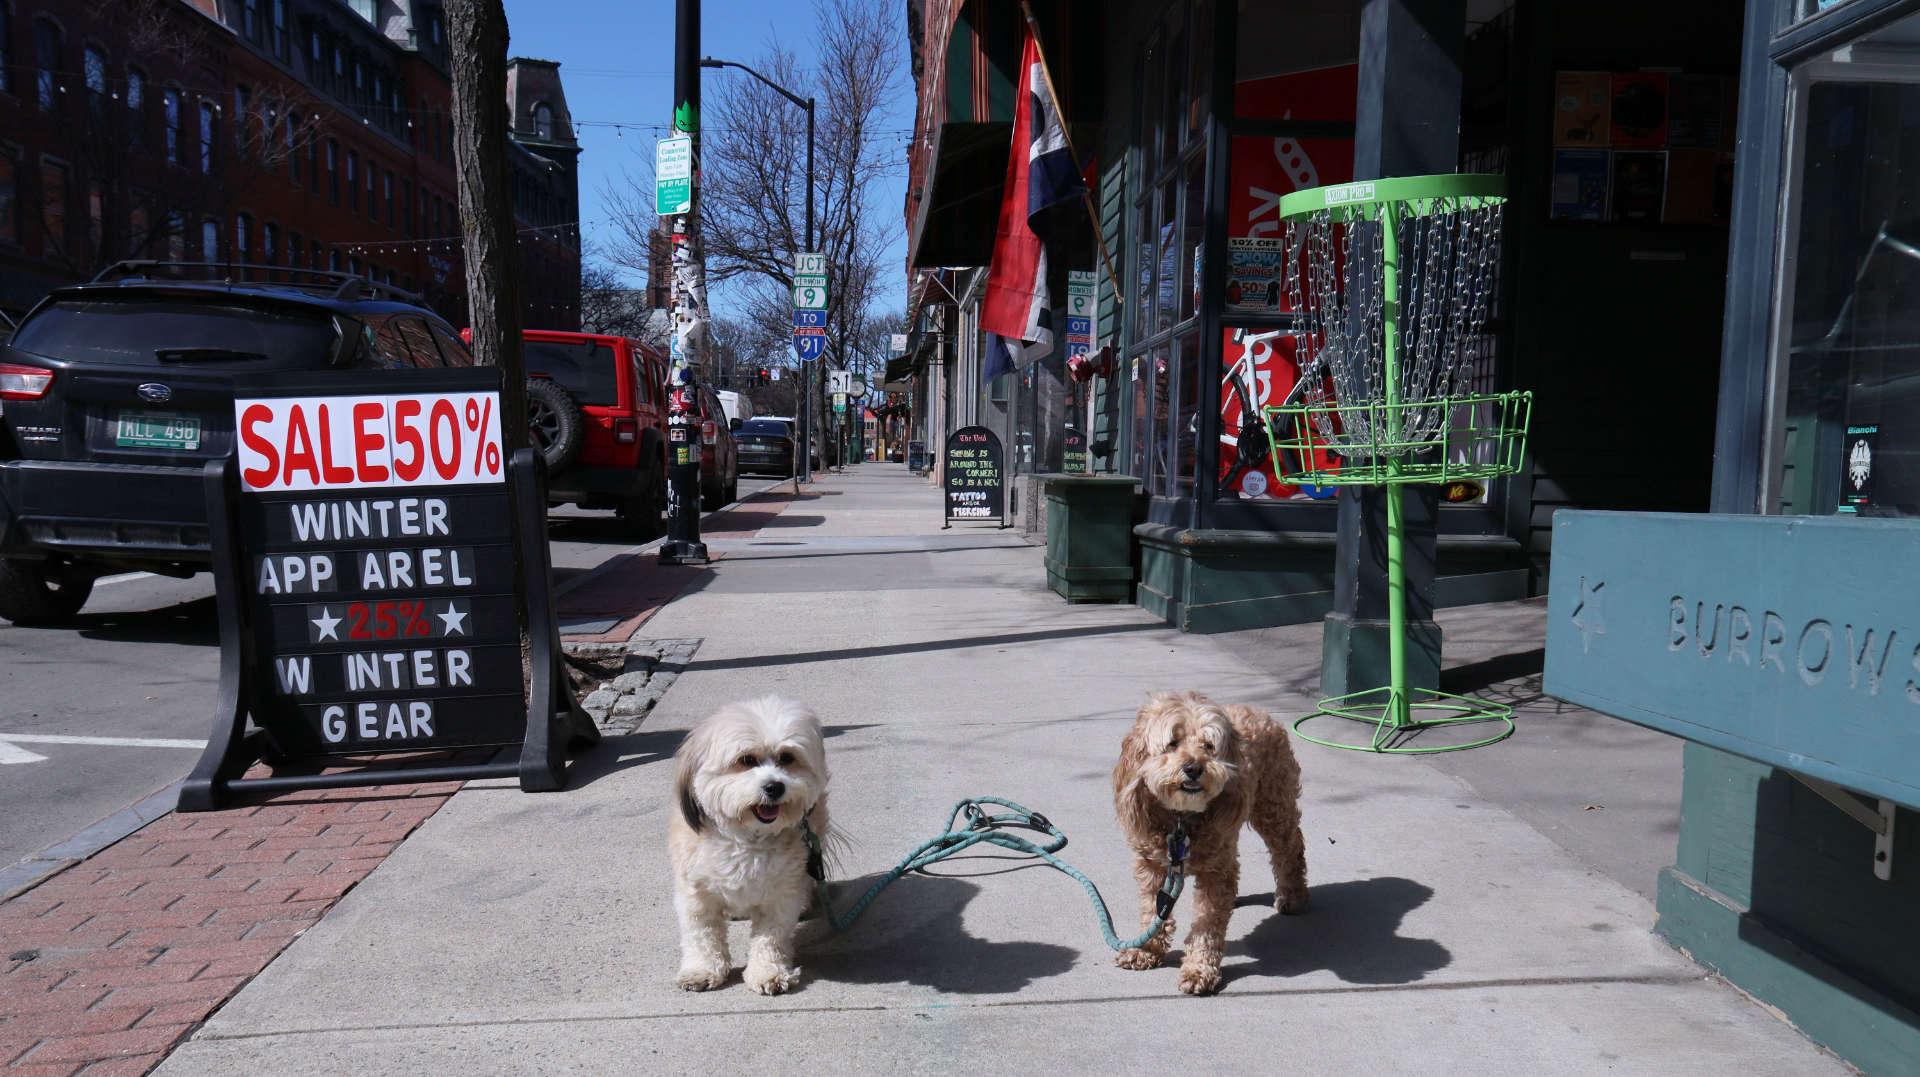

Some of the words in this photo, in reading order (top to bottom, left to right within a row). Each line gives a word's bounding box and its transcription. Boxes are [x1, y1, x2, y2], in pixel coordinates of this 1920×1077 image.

[798, 257, 823, 271] JCT
[804, 289, 816, 306] 9
[803, 313, 817, 324] TO
[801, 337, 818, 353] 91
[1847, 426, 1878, 434] Bianchi
[241, 404, 389, 488] SALE
[394, 397, 500, 482] 50%
[960, 434, 972, 442] The
[973, 434, 987, 442] Void
[979, 449, 988, 458] IS
[949, 460, 977, 469] AROUND
[979, 461, 993, 469] THE
[950, 491, 987, 502] TATTOO
[1450, 486, 1465, 499] K2
[952, 506, 992, 517] PIERCING
[291, 498, 449, 541] WINTER
[348, 600, 431, 640] 25%
[322, 701, 434, 744] GEAR
